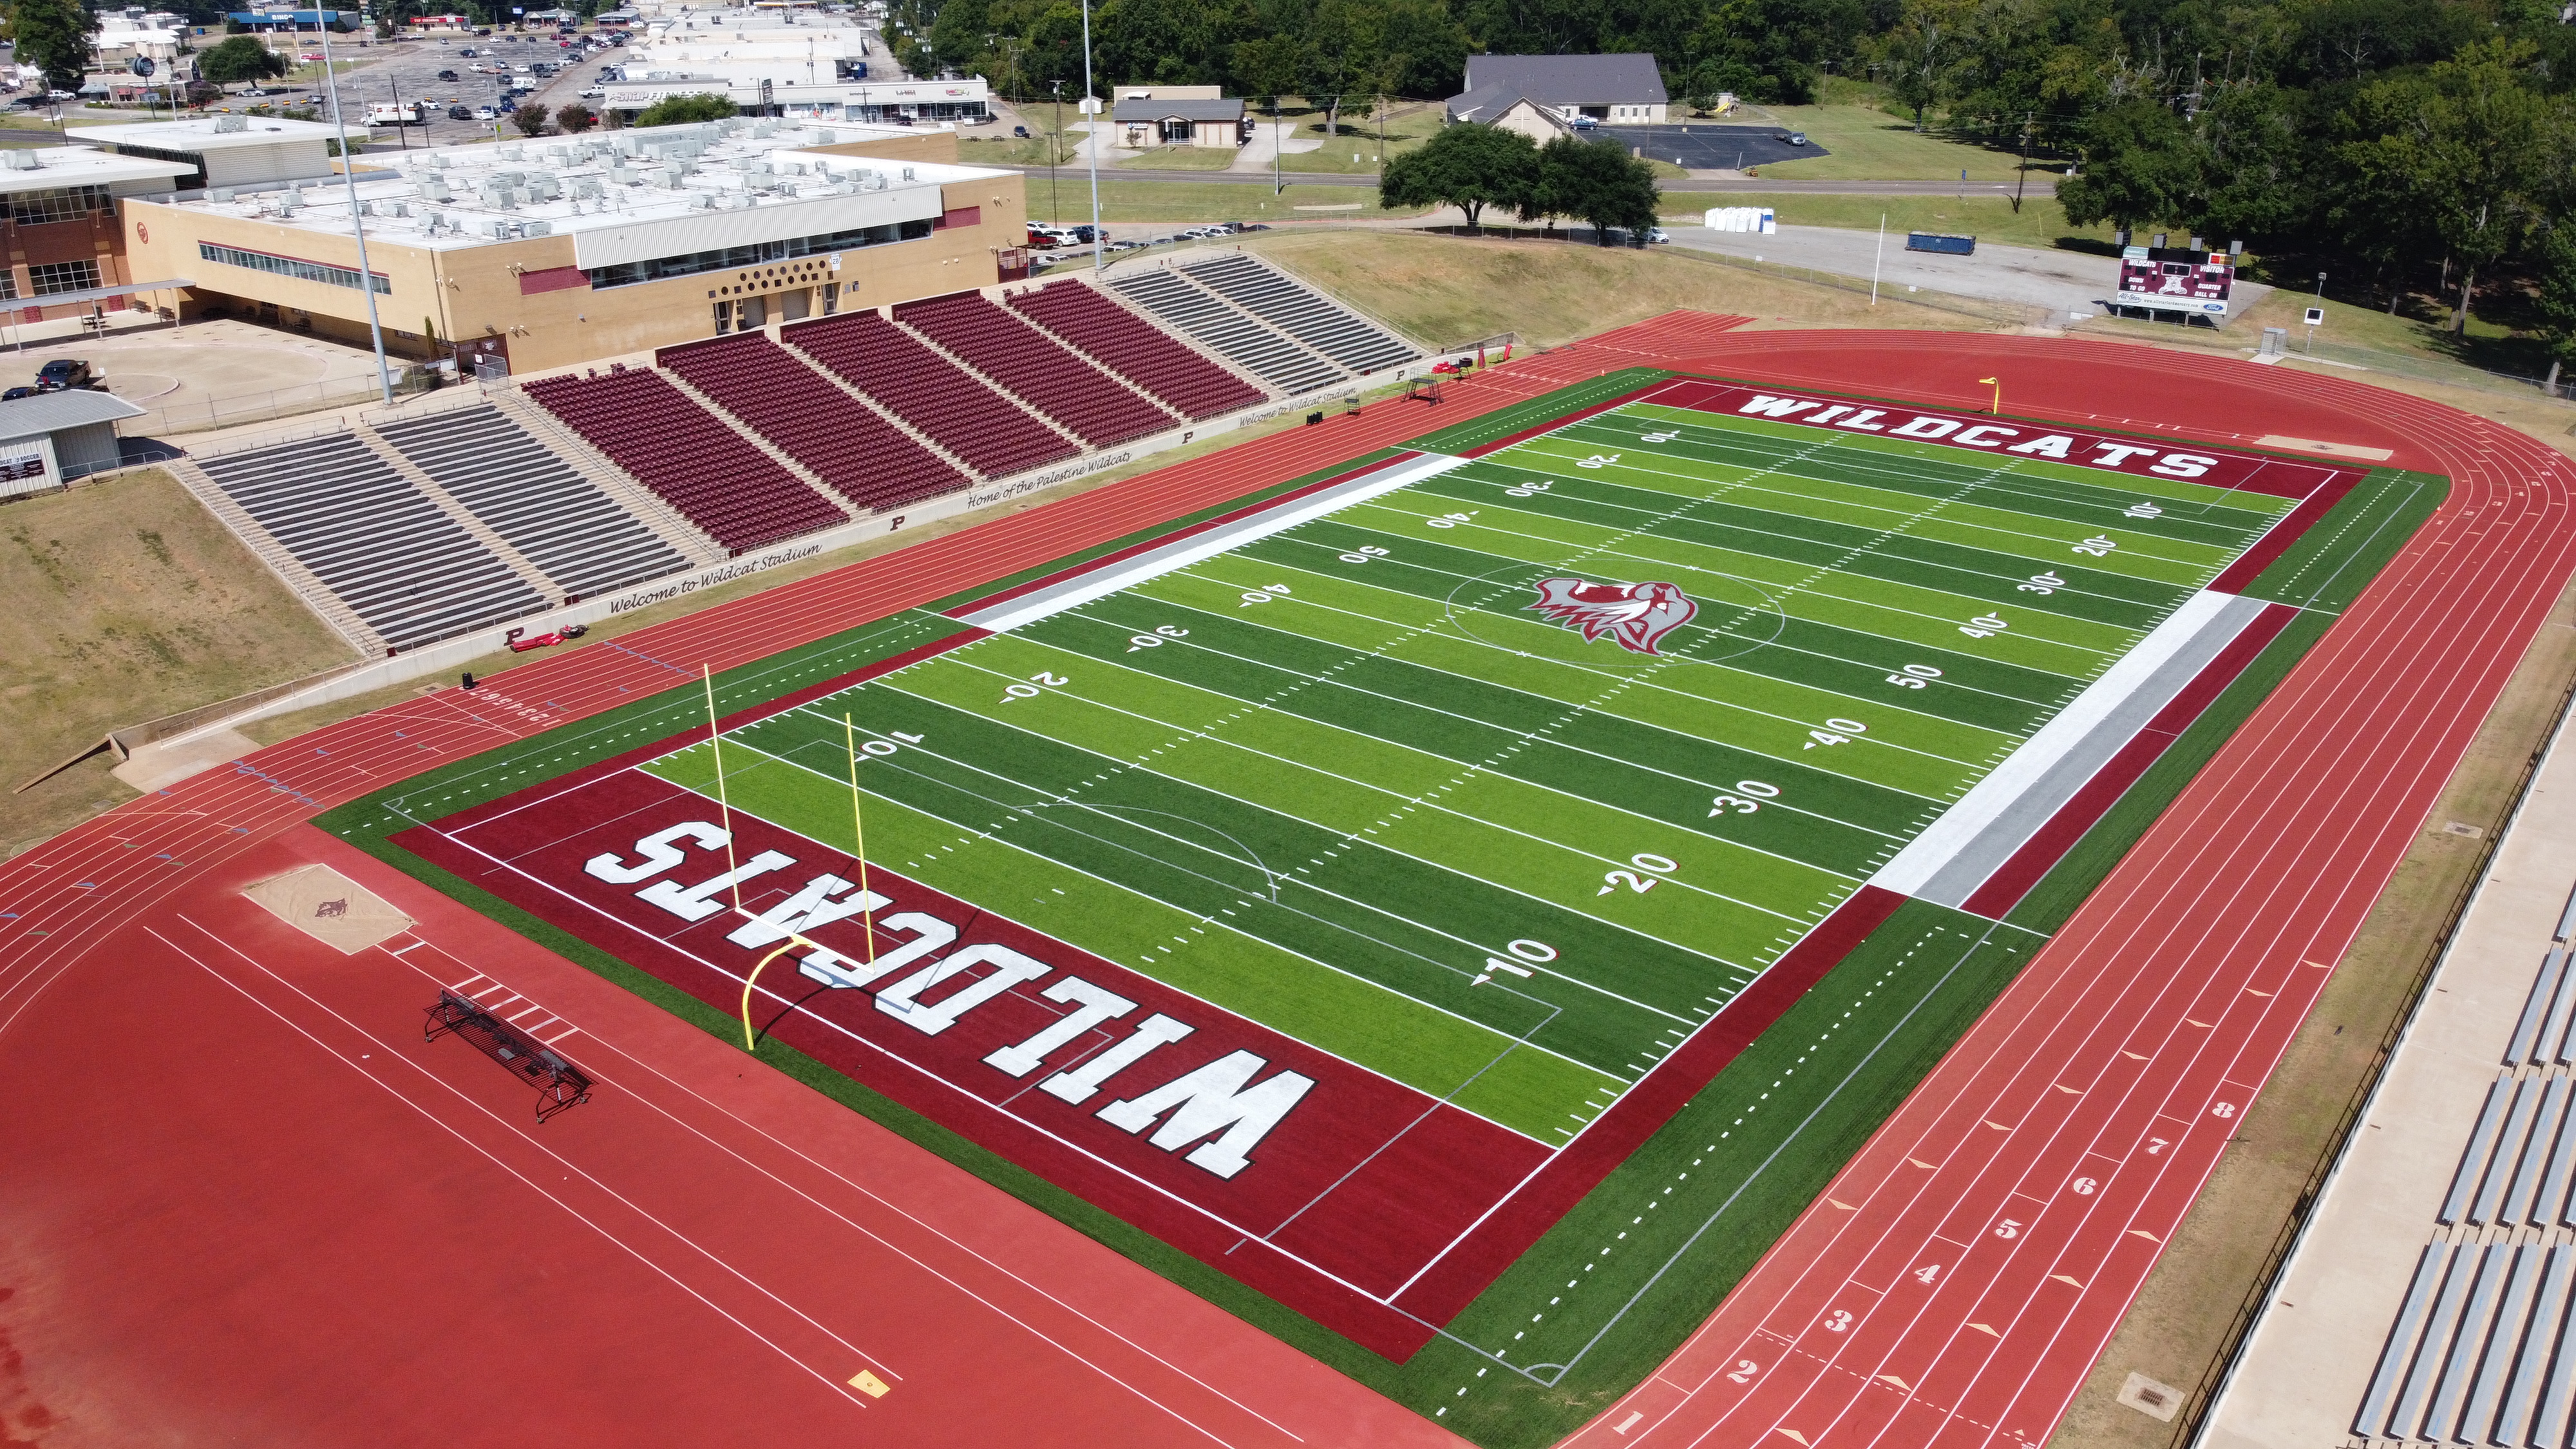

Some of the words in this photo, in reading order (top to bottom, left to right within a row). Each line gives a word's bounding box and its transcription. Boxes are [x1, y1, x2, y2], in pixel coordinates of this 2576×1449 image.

[2128, 260, 2157, 268] WILDCATS
[2200, 265, 2225, 274] VISITOR
[1238, 409, 1277, 427] Welcome
[1278, 406, 1288, 415] to
[1288, 396, 1321, 413] Wildcat
[1322, 386, 1357, 403] Stadium
[1182, 431, 1194, 444] P
[1738, 394, 2219, 478] WILDCATS
[21, 453, 40, 462] SOCCER
[1575, 453, 1614, 469] 20
[967, 489, 1001, 509] Home
[1002, 483, 1016, 501] of
[1016, 480, 1036, 496] the
[1036, 465, 1086, 489] Palestine
[1087, 450, 1133, 473] Wildcats
[1504, 481, 1548, 498] 30
[890, 515, 905, 532] P
[1426, 511, 1472, 529] 40
[2124, 505, 2163, 520] 10
[1338, 545, 1390, 565] 50
[2072, 538, 2117, 557] 20
[609, 585, 679, 614] Welcome
[680, 578, 699, 594] to
[700, 562, 758, 587] Wildcat
[761, 542, 823, 570] Stadium
[2016, 575, 2065, 595] 30
[1240, 583, 1292, 606] 40
[504, 627, 525, 647] P
[1130, 625, 1189, 649] 30
[1958, 617, 2010, 639] 40
[1005, 671, 1069, 700] 20
[1886, 664, 1943, 690] 50
[1809, 717, 1869, 747] 40
[859, 730, 925, 757] 10
[1713, 779, 1783, 815] 30
[1604, 853, 1680, 894] 20
[1485, 938, 1559, 978] 10
[582, 820, 1319, 1182] WILDCATS
[2211, 1102, 2236, 1119] 8
[2147, 1137, 2170, 1156] 7
[2071, 1177, 2098, 1196] 6
[1994, 1218, 2022, 1240] 5
[1913, 1263, 1942, 1285] 4
[1824, 1309, 1855, 1332] 3
[1727, 1359, 1759, 1385] 2
[1611, 1410, 1645, 1435] 1
